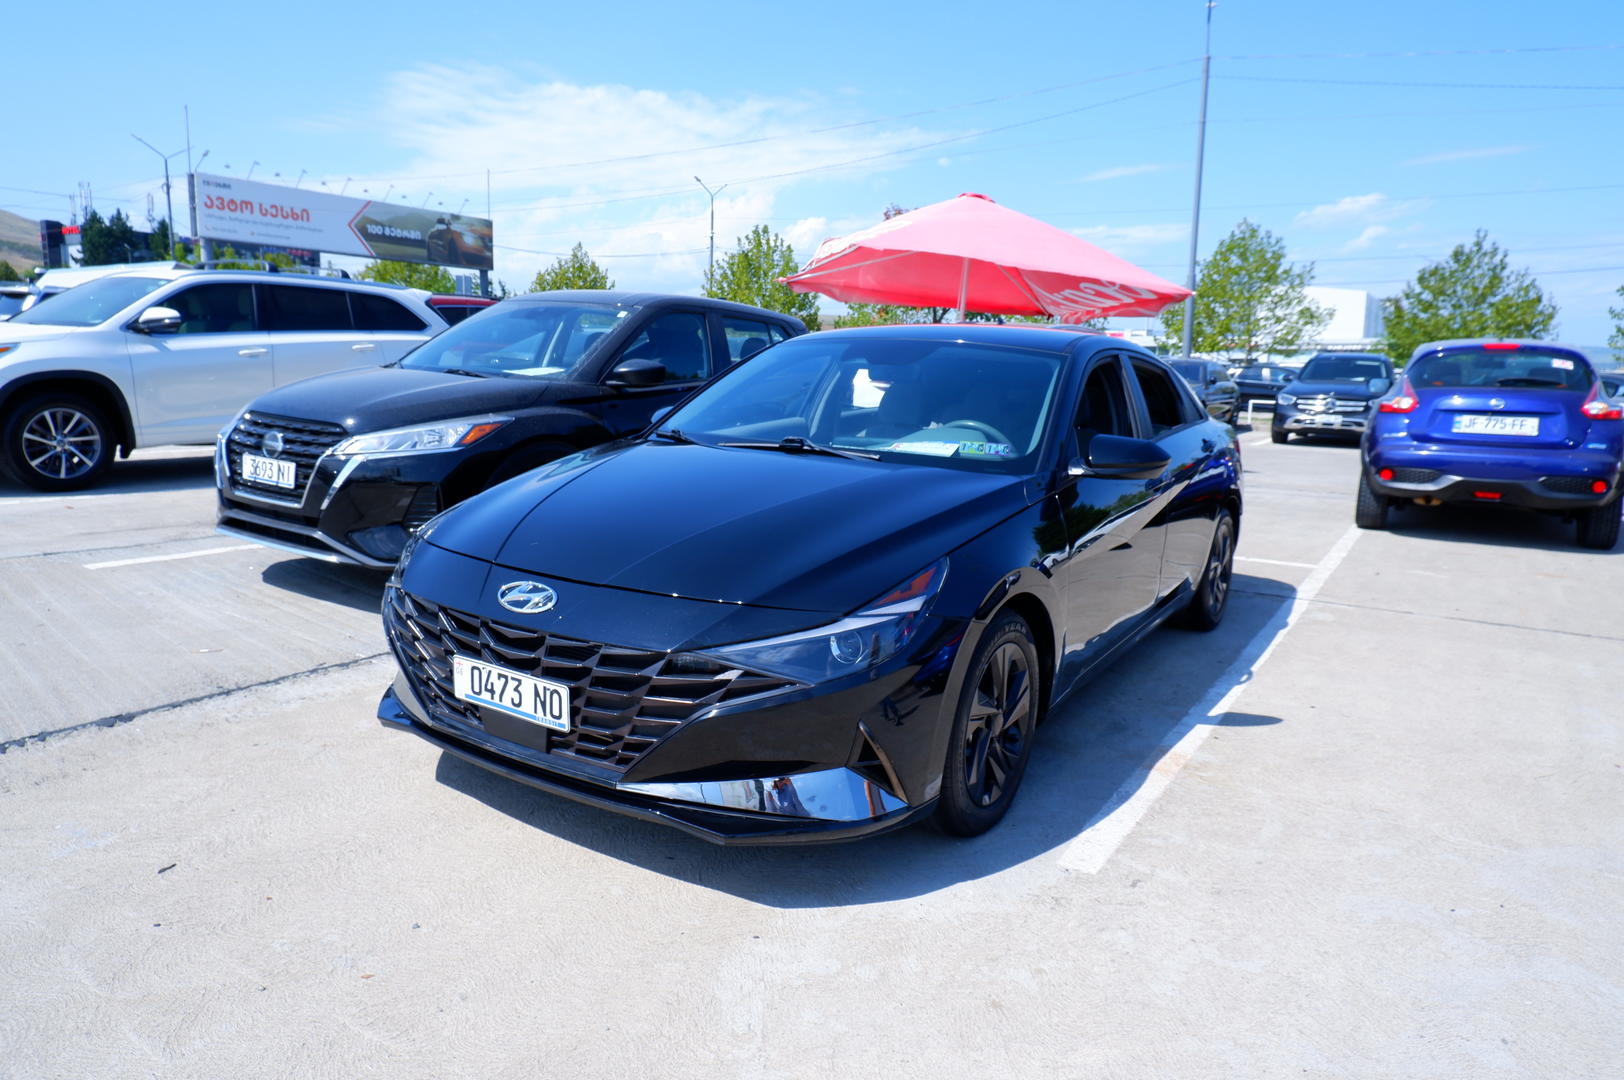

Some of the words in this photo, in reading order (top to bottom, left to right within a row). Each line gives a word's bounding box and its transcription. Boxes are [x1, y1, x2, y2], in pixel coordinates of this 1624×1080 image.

[204, 194, 254, 216] ავტო
[259, 202, 310, 222] სესხი
[366, 223, 383, 235] 100
[250, 458, 273, 479] 3693
[471, 666, 522, 708] 0473
[534, 683, 562, 720] NO
